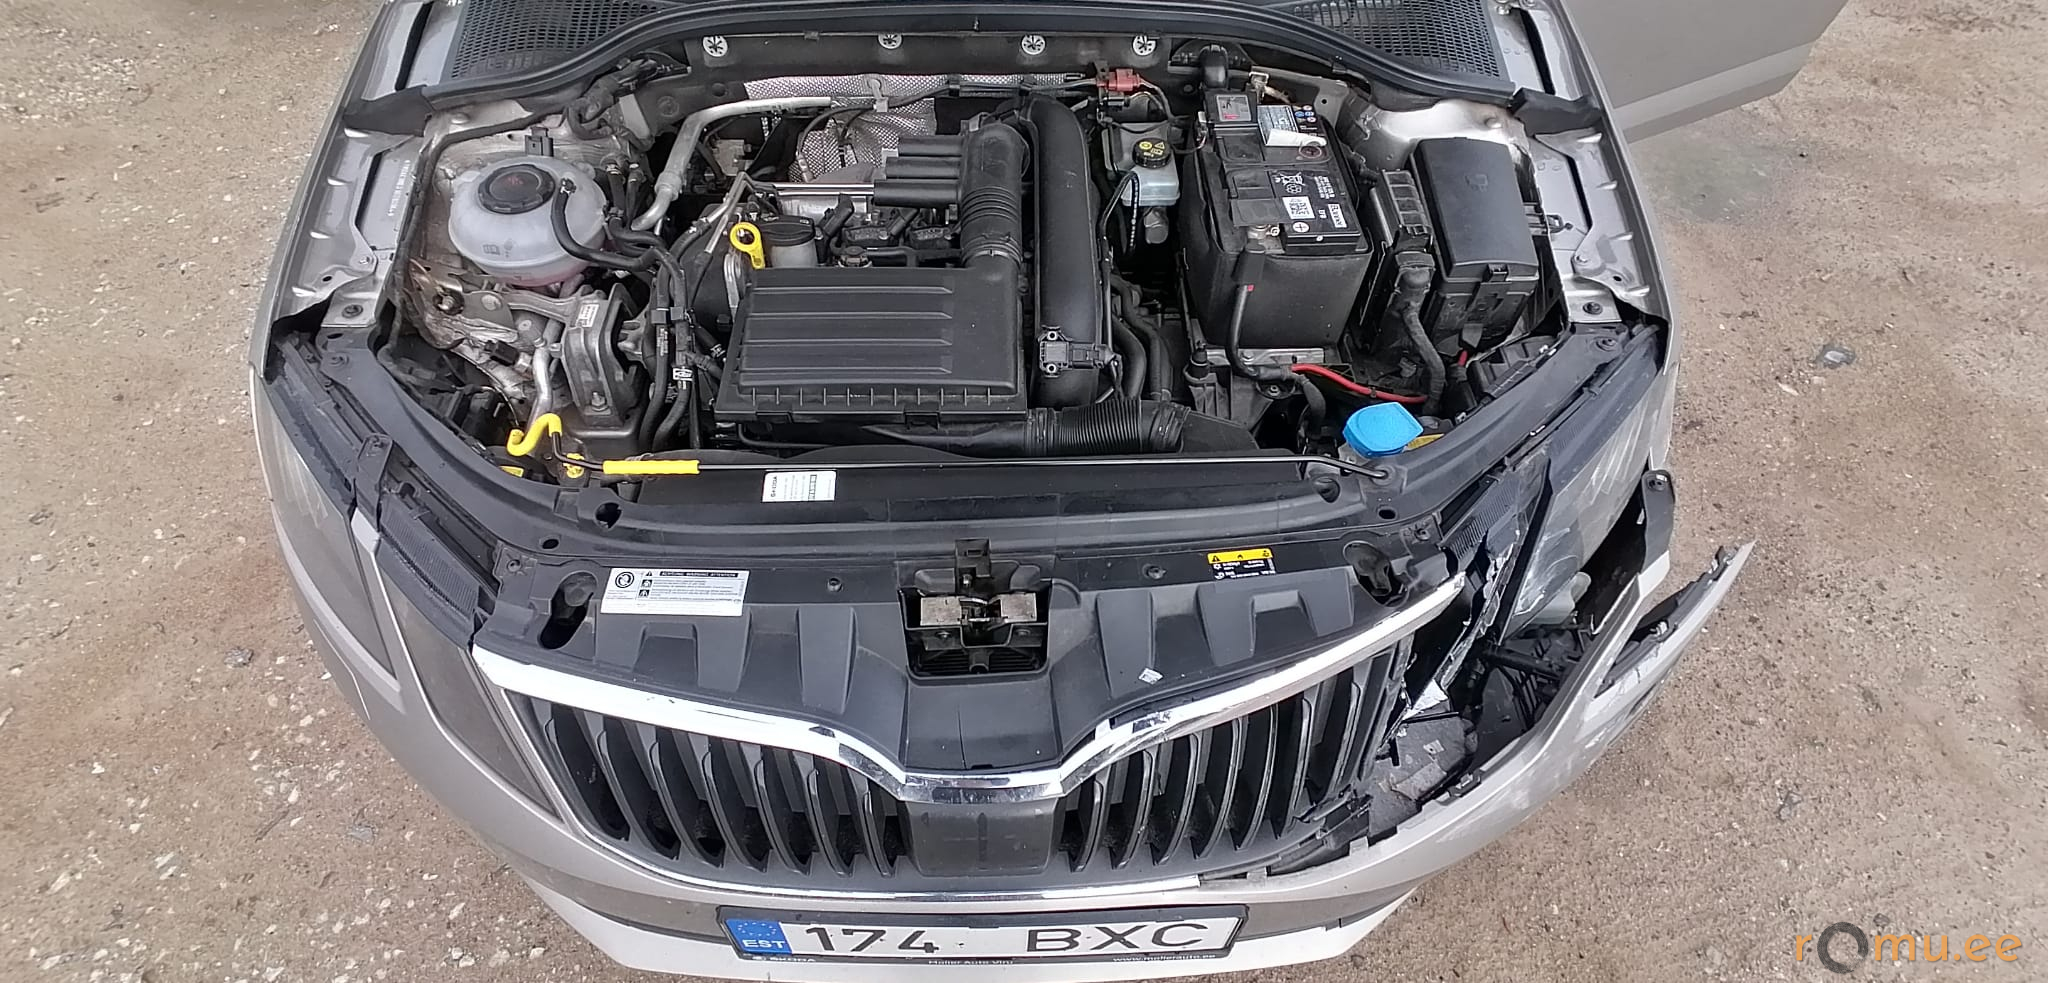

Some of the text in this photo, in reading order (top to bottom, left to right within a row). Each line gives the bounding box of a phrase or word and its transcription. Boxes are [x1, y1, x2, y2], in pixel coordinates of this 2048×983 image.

[742, 939, 786, 949] EST
[806, 923, 1209, 954] 174 BXC
